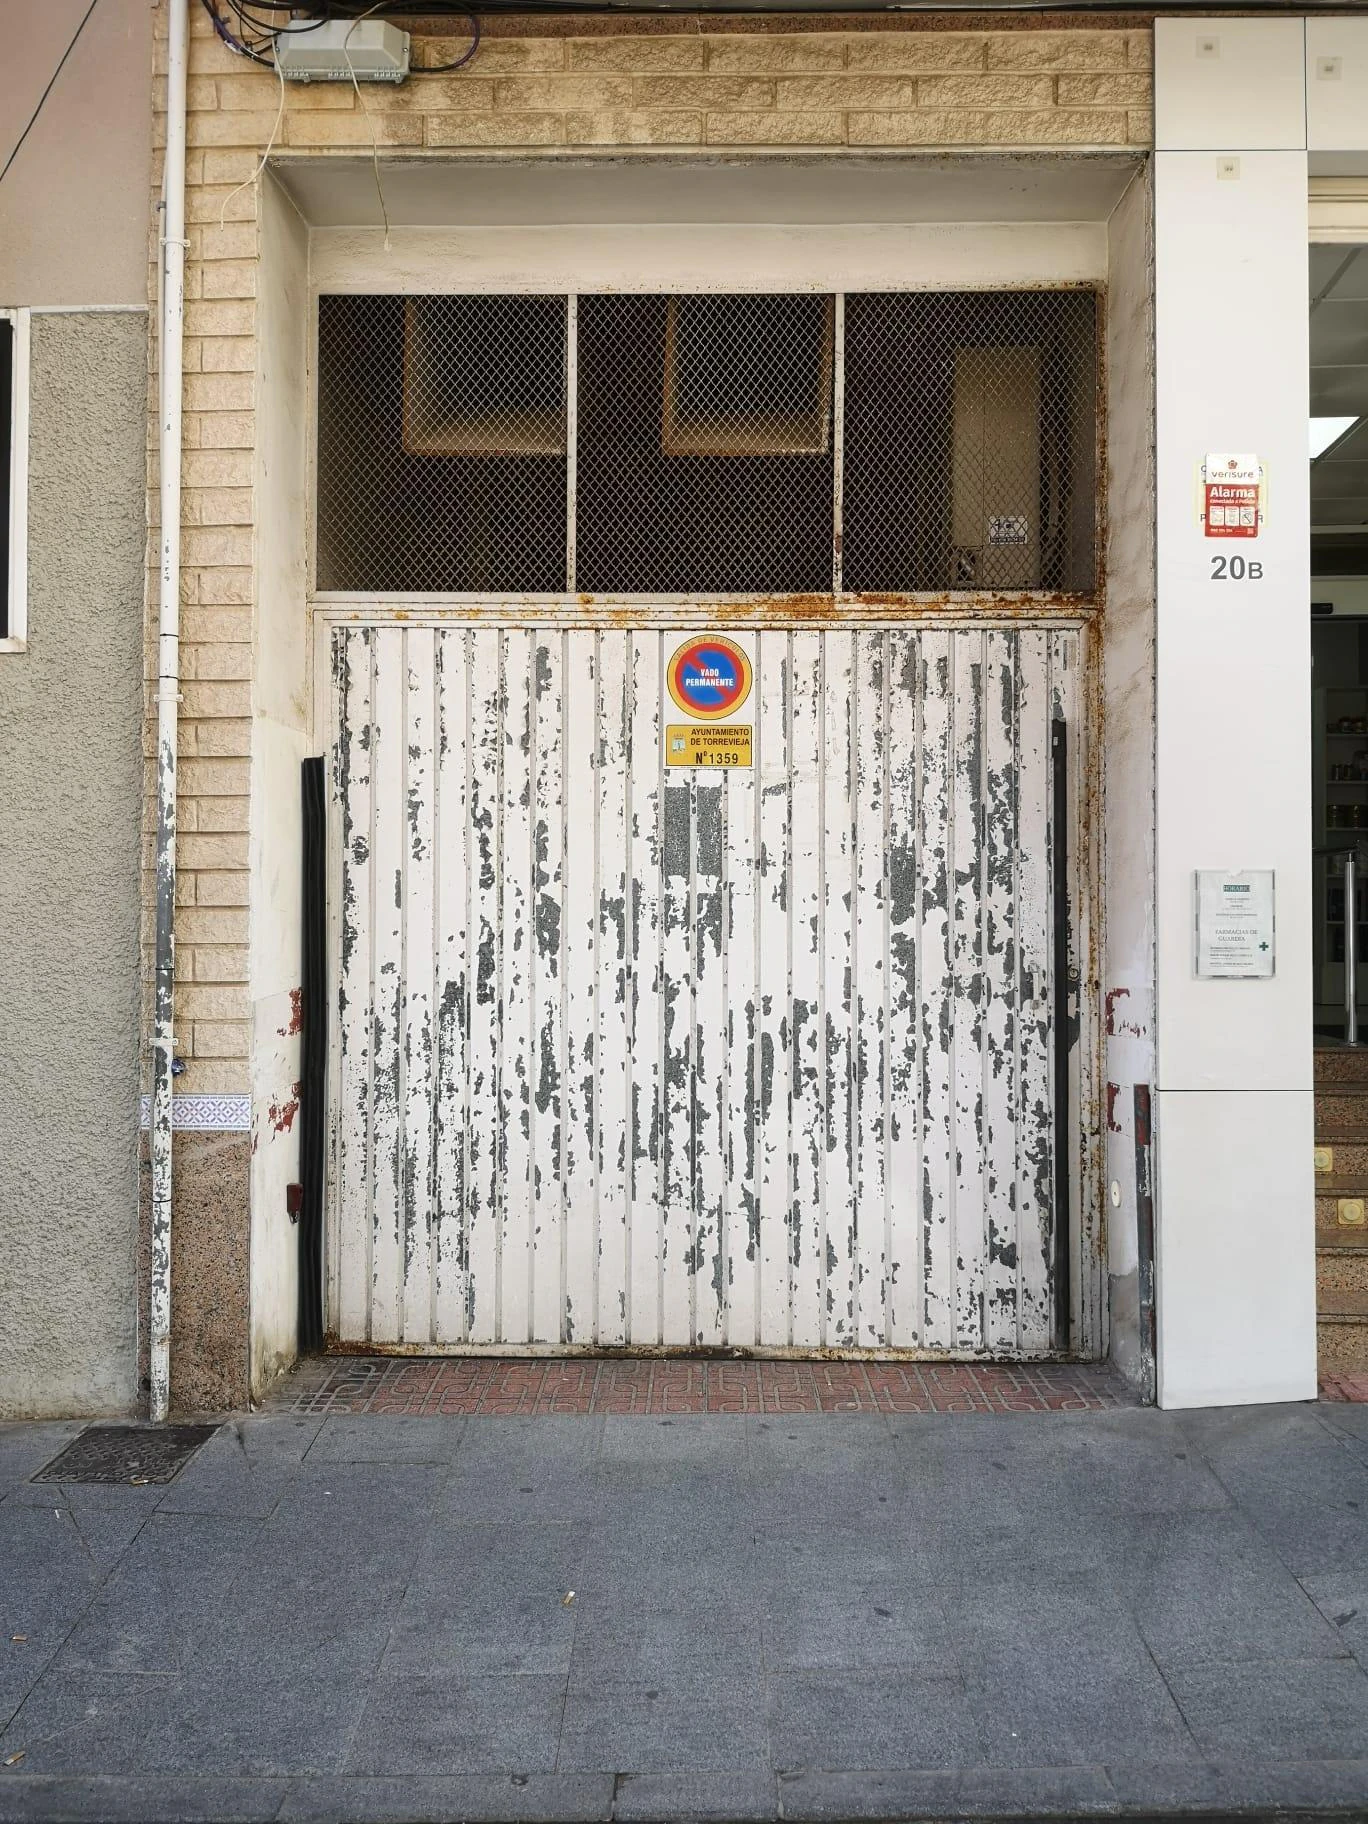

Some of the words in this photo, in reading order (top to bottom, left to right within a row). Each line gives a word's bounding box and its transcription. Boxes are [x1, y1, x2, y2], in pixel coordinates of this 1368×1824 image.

[1210, 485, 1255, 498] Alarma
[1210, 555, 1264, 580] 20B
[700, 668, 719, 677] VADO
[685, 678, 734, 687] PERMANENTE
[690, 728, 750, 736] AYUNTAMIENTO
[690, 738, 701, 746] DE
[703, 738, 750, 746] TORREVIEJA
